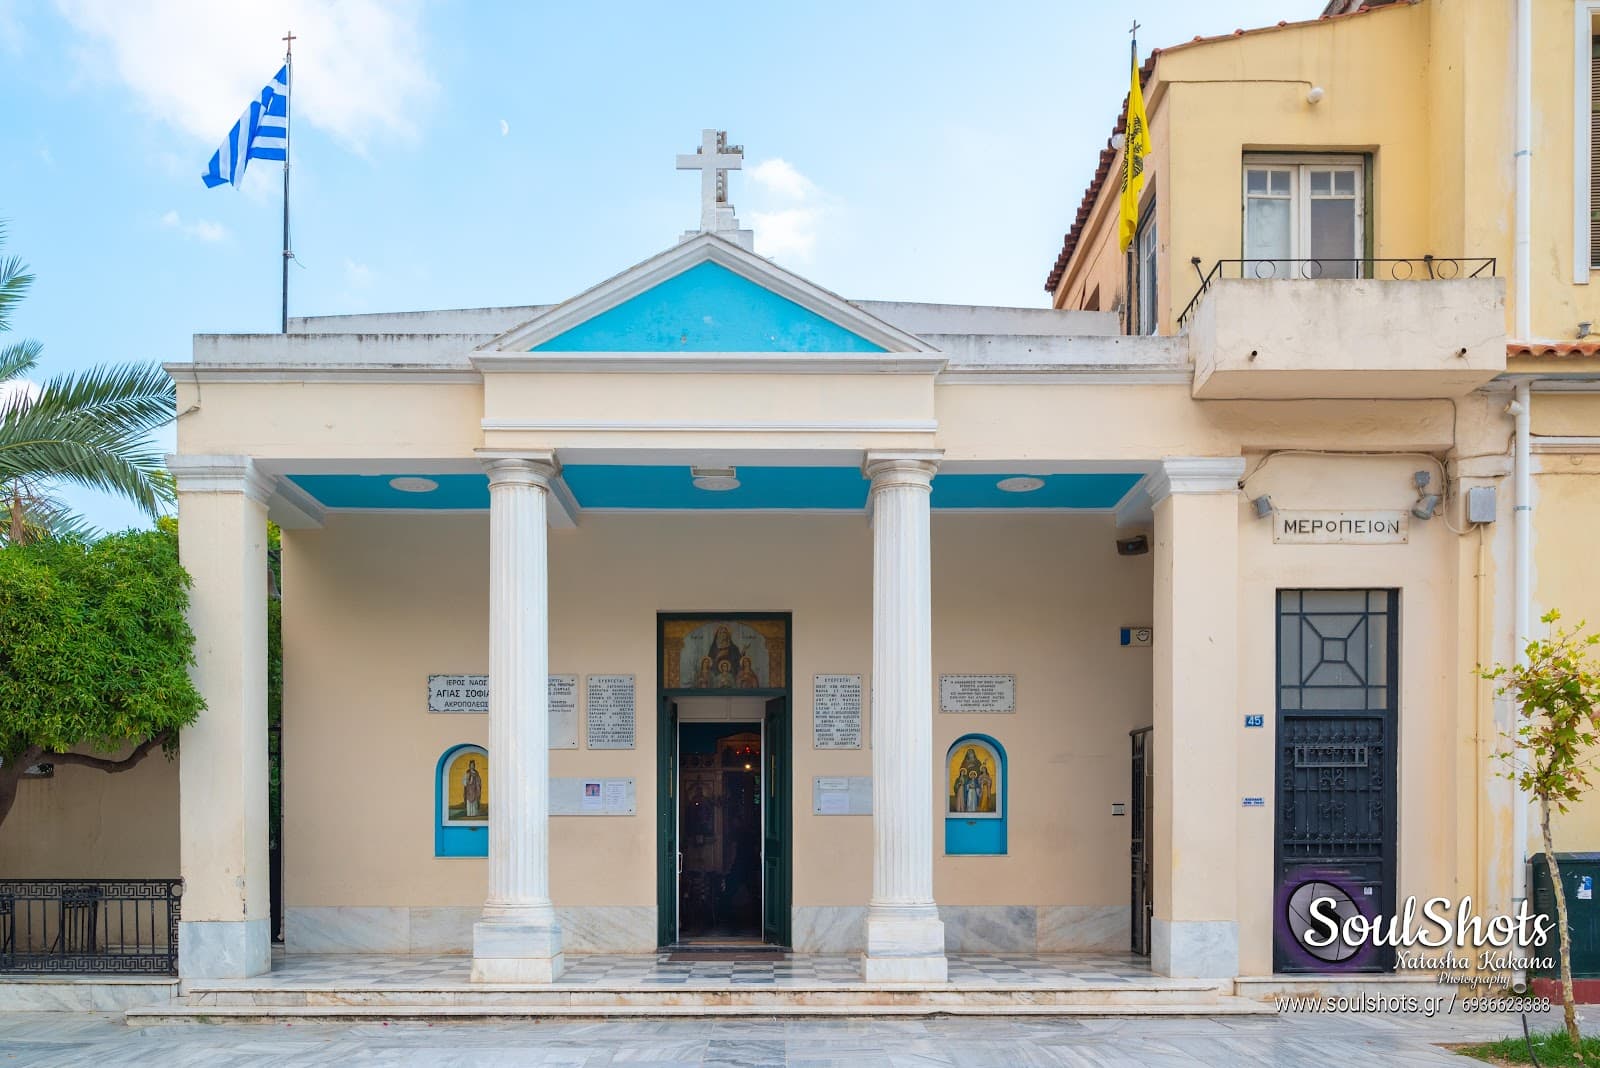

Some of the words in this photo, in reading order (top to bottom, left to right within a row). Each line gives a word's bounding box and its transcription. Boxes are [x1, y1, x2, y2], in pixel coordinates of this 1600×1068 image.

[1284, 519, 1399, 534] ΜΕΡΟΠΕΙΟΝ
[436, 689, 461, 698] ΑΓΙΑΣ
[444, 700, 489, 708] ΑΚΡΟΠΟΛΕΩΣ
[1247, 715, 1261, 726] 45
